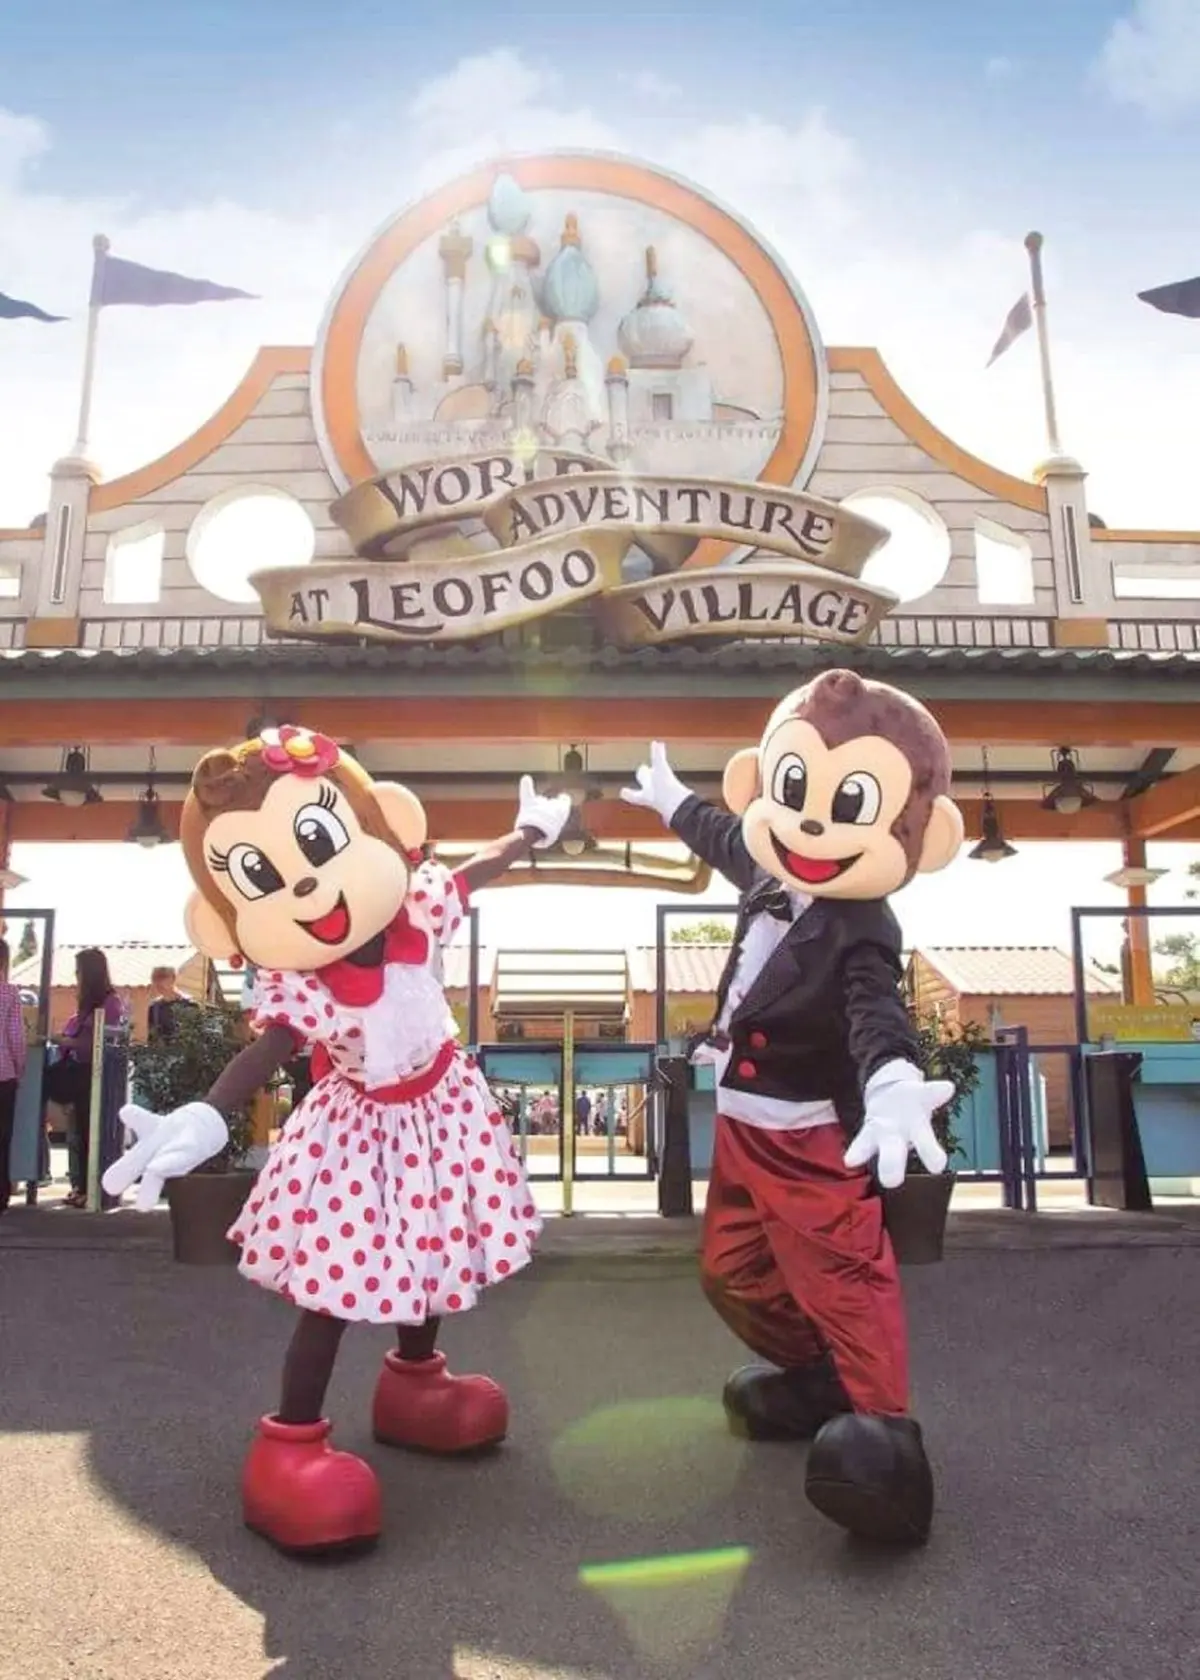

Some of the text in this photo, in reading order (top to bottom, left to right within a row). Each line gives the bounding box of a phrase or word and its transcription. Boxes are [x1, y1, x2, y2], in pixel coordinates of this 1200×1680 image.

[510, 486, 835, 555] ADVENTURE
[289, 549, 596, 635] AT LEOFOO
[631, 582, 869, 634] VILLAGE
